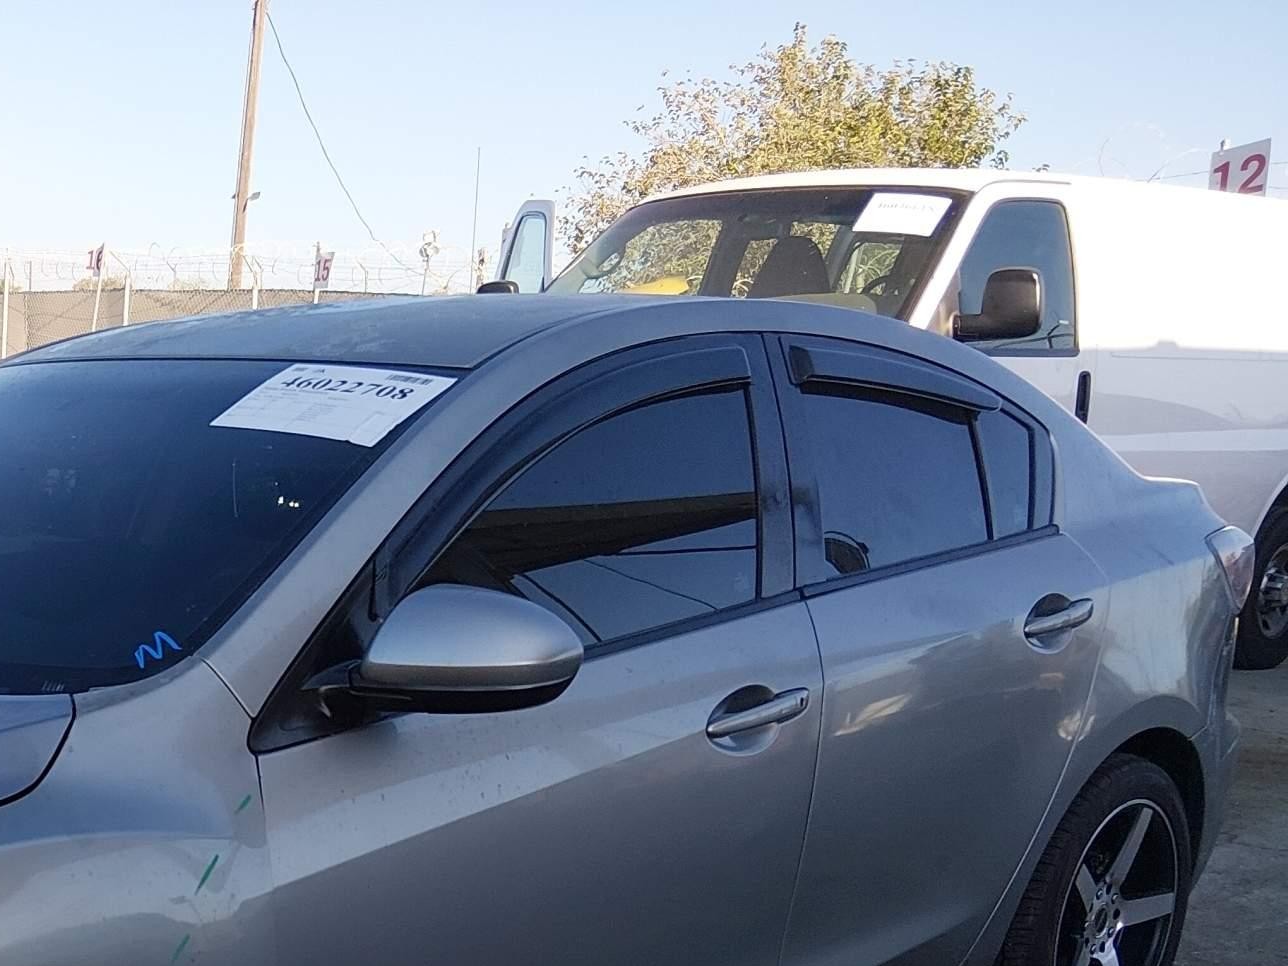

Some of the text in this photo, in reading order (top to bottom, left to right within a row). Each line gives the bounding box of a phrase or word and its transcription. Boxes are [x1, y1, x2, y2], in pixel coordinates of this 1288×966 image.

[1213, 153, 1267, 194] 12
[315, 258, 332, 281] 15
[281, 376, 415, 400] 46022708
